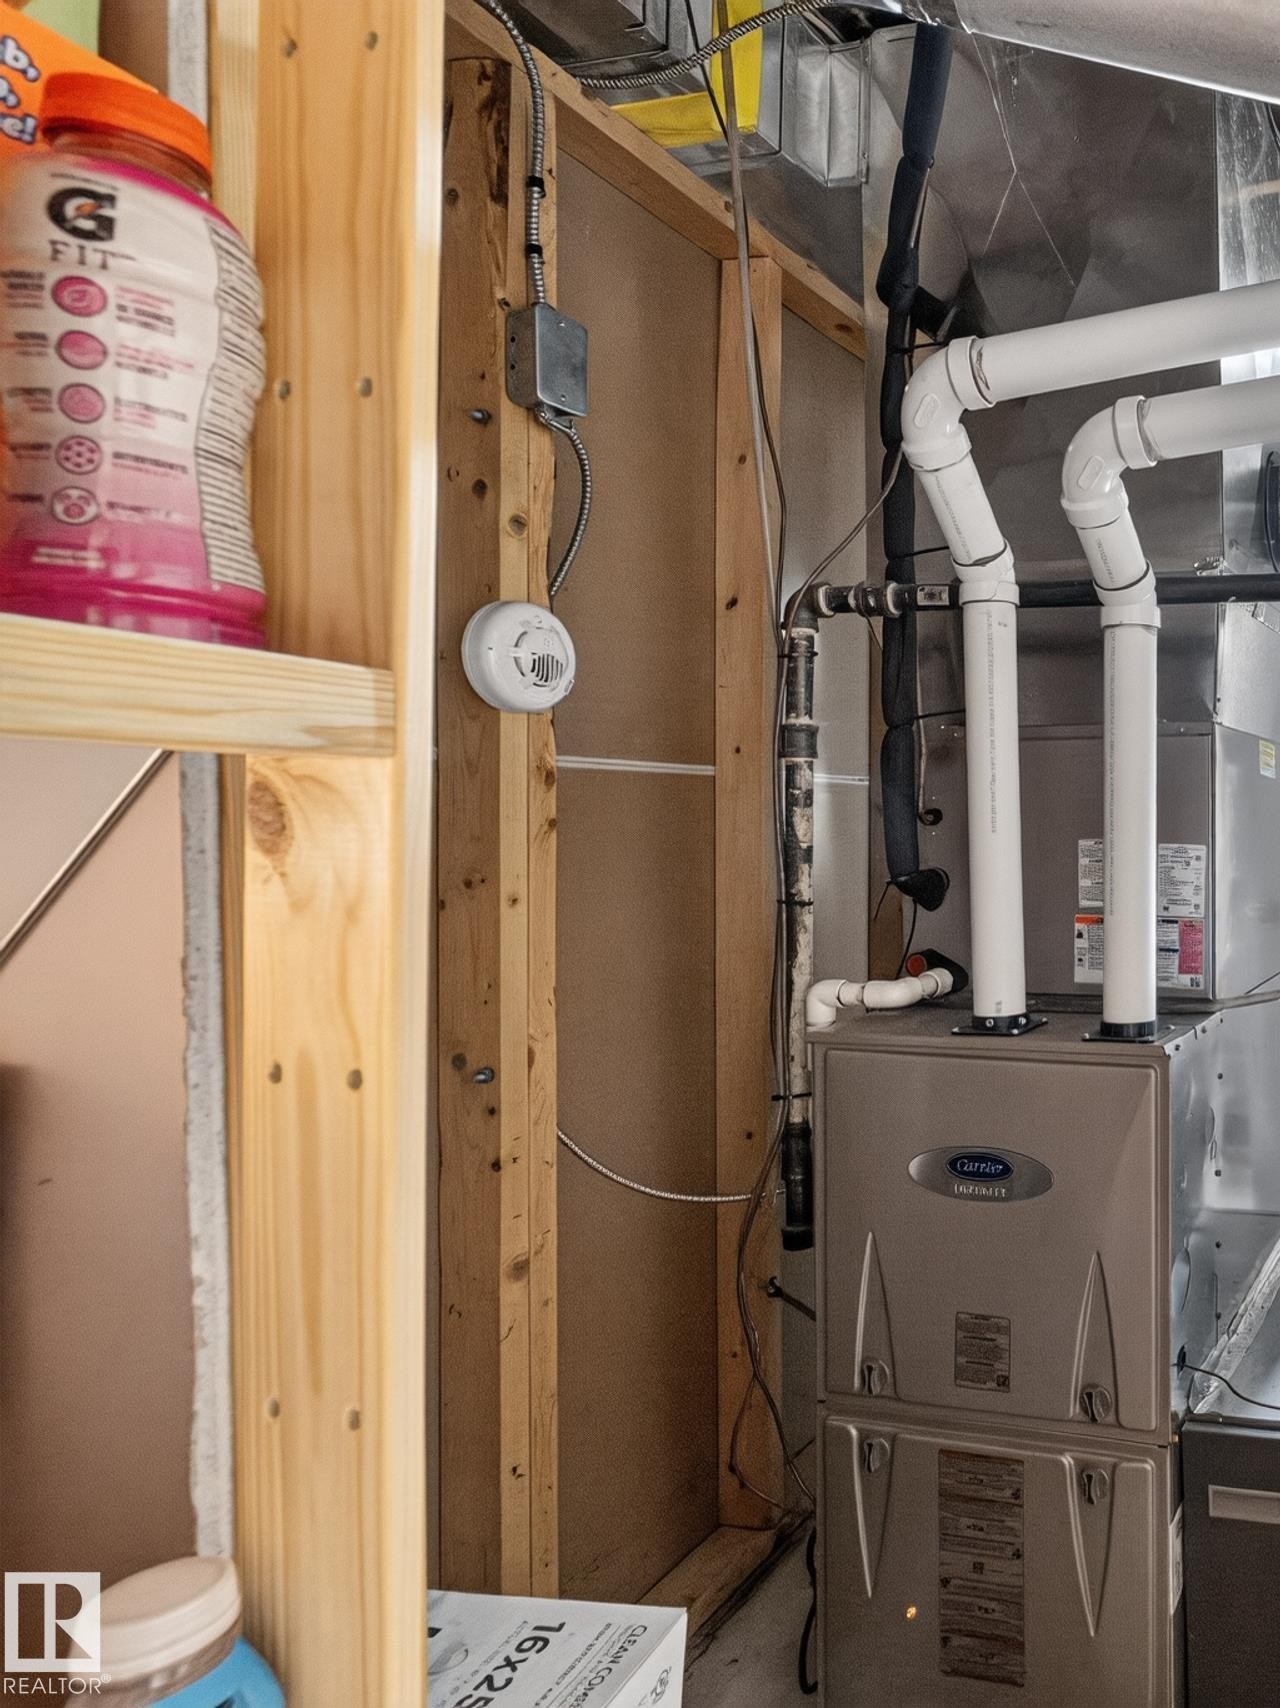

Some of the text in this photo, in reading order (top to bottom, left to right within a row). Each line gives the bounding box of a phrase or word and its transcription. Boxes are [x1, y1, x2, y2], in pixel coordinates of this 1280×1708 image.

[48, 187, 116, 241] G
[49, 239, 136, 270] FIT
[957, 1159, 1004, 1173] Carrier
